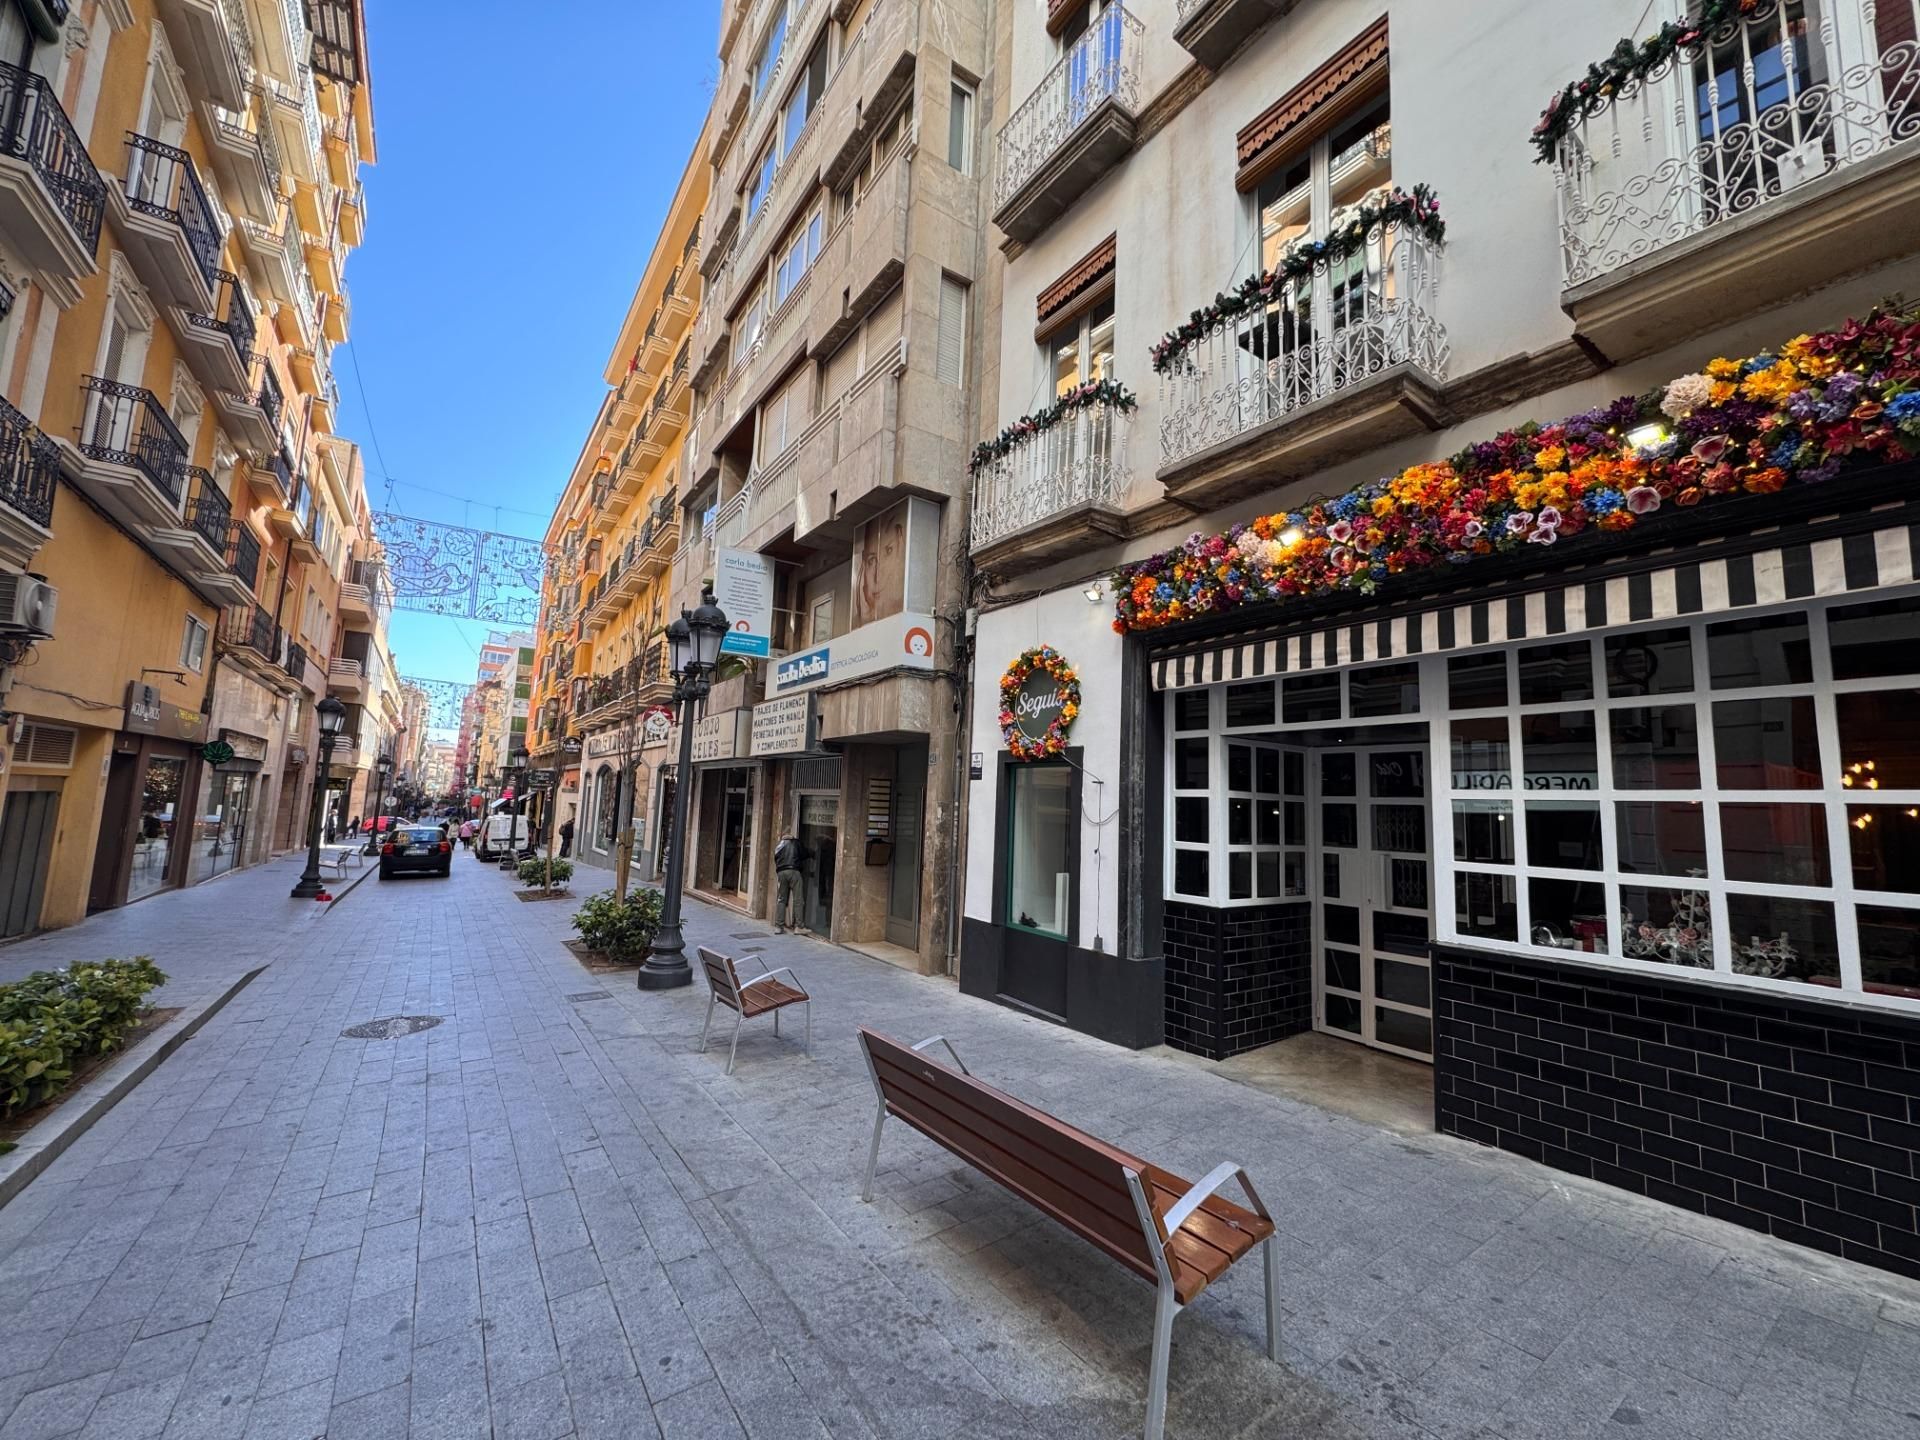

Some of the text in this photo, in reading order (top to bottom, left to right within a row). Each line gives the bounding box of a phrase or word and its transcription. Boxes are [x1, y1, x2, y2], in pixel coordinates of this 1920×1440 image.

[780, 697, 806, 711] FLAMENCA
[754, 710, 805, 727] MANTONES DE MANILA
